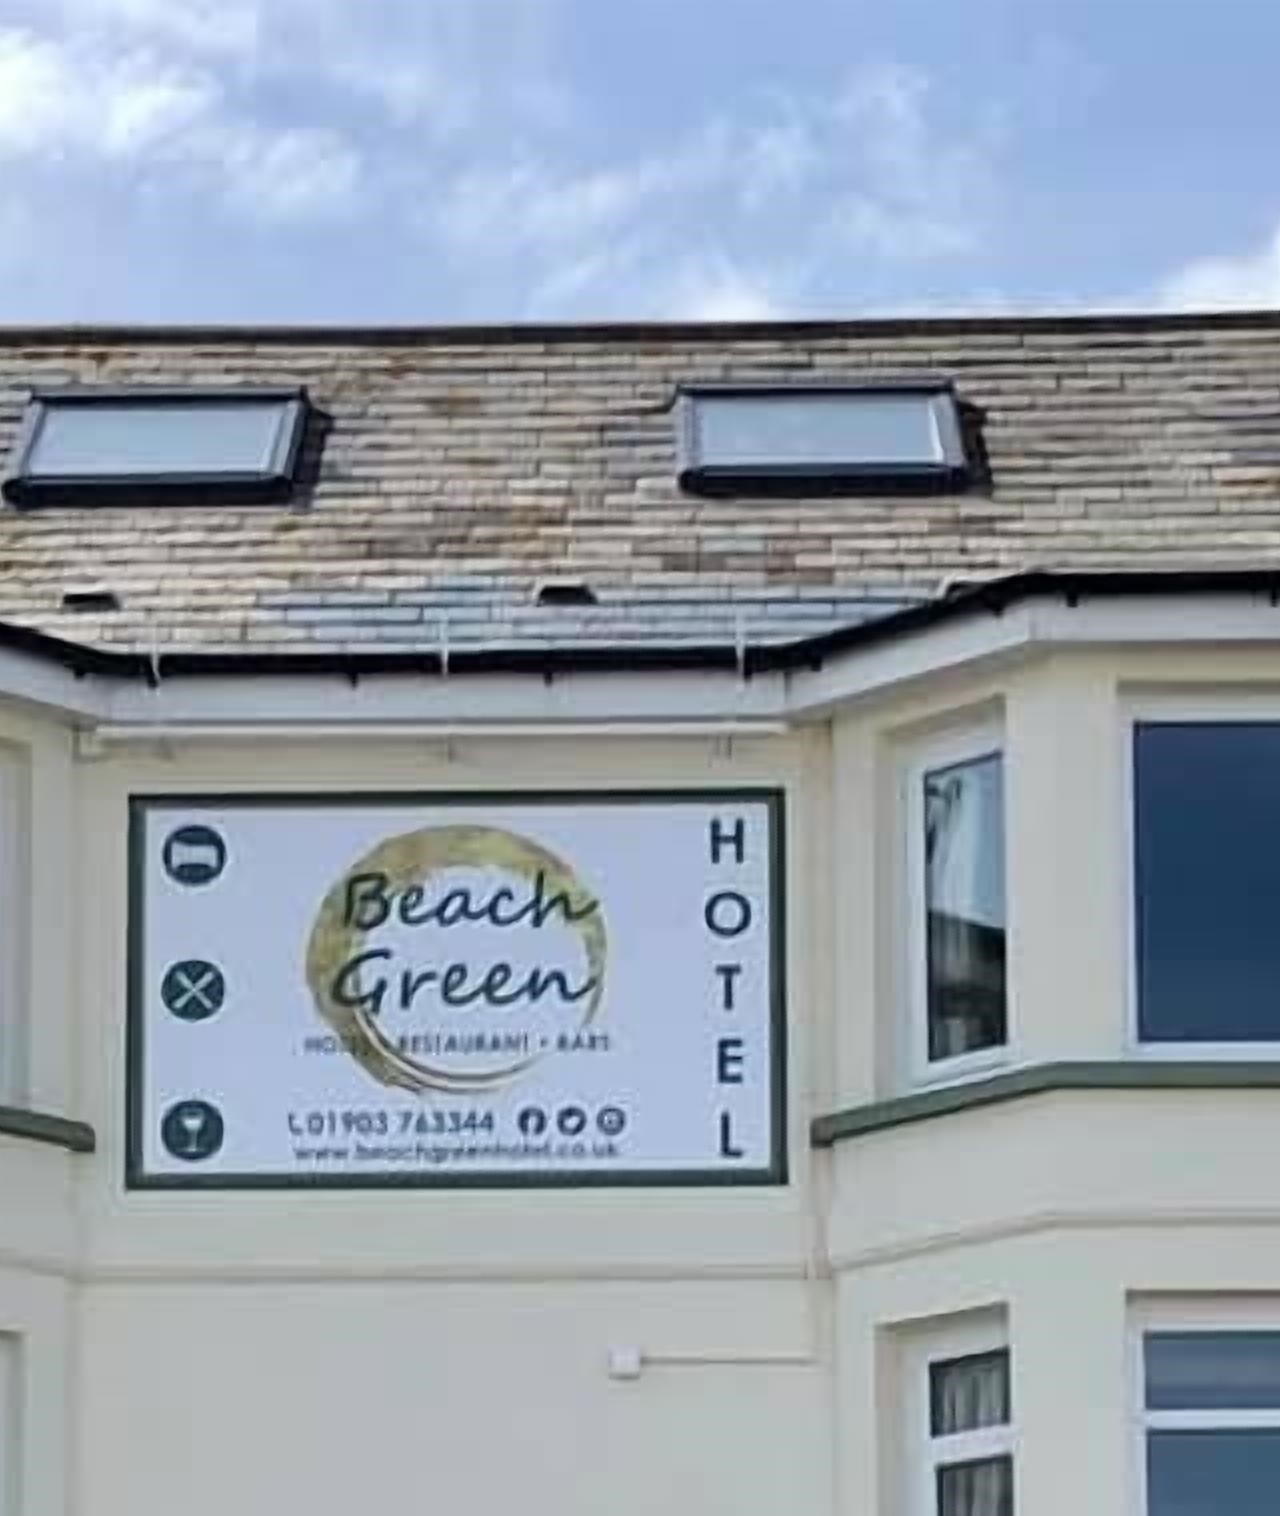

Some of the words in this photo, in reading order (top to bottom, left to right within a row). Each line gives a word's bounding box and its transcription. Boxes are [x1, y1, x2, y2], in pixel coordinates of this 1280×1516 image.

[344, 869, 599, 931] Beach
[330, 948, 598, 1015] Green
[704, 818, 752, 1159] HOTEL
[307, 1111, 388, 1136] 01903
[400, 1111, 495, 1135] 763344
